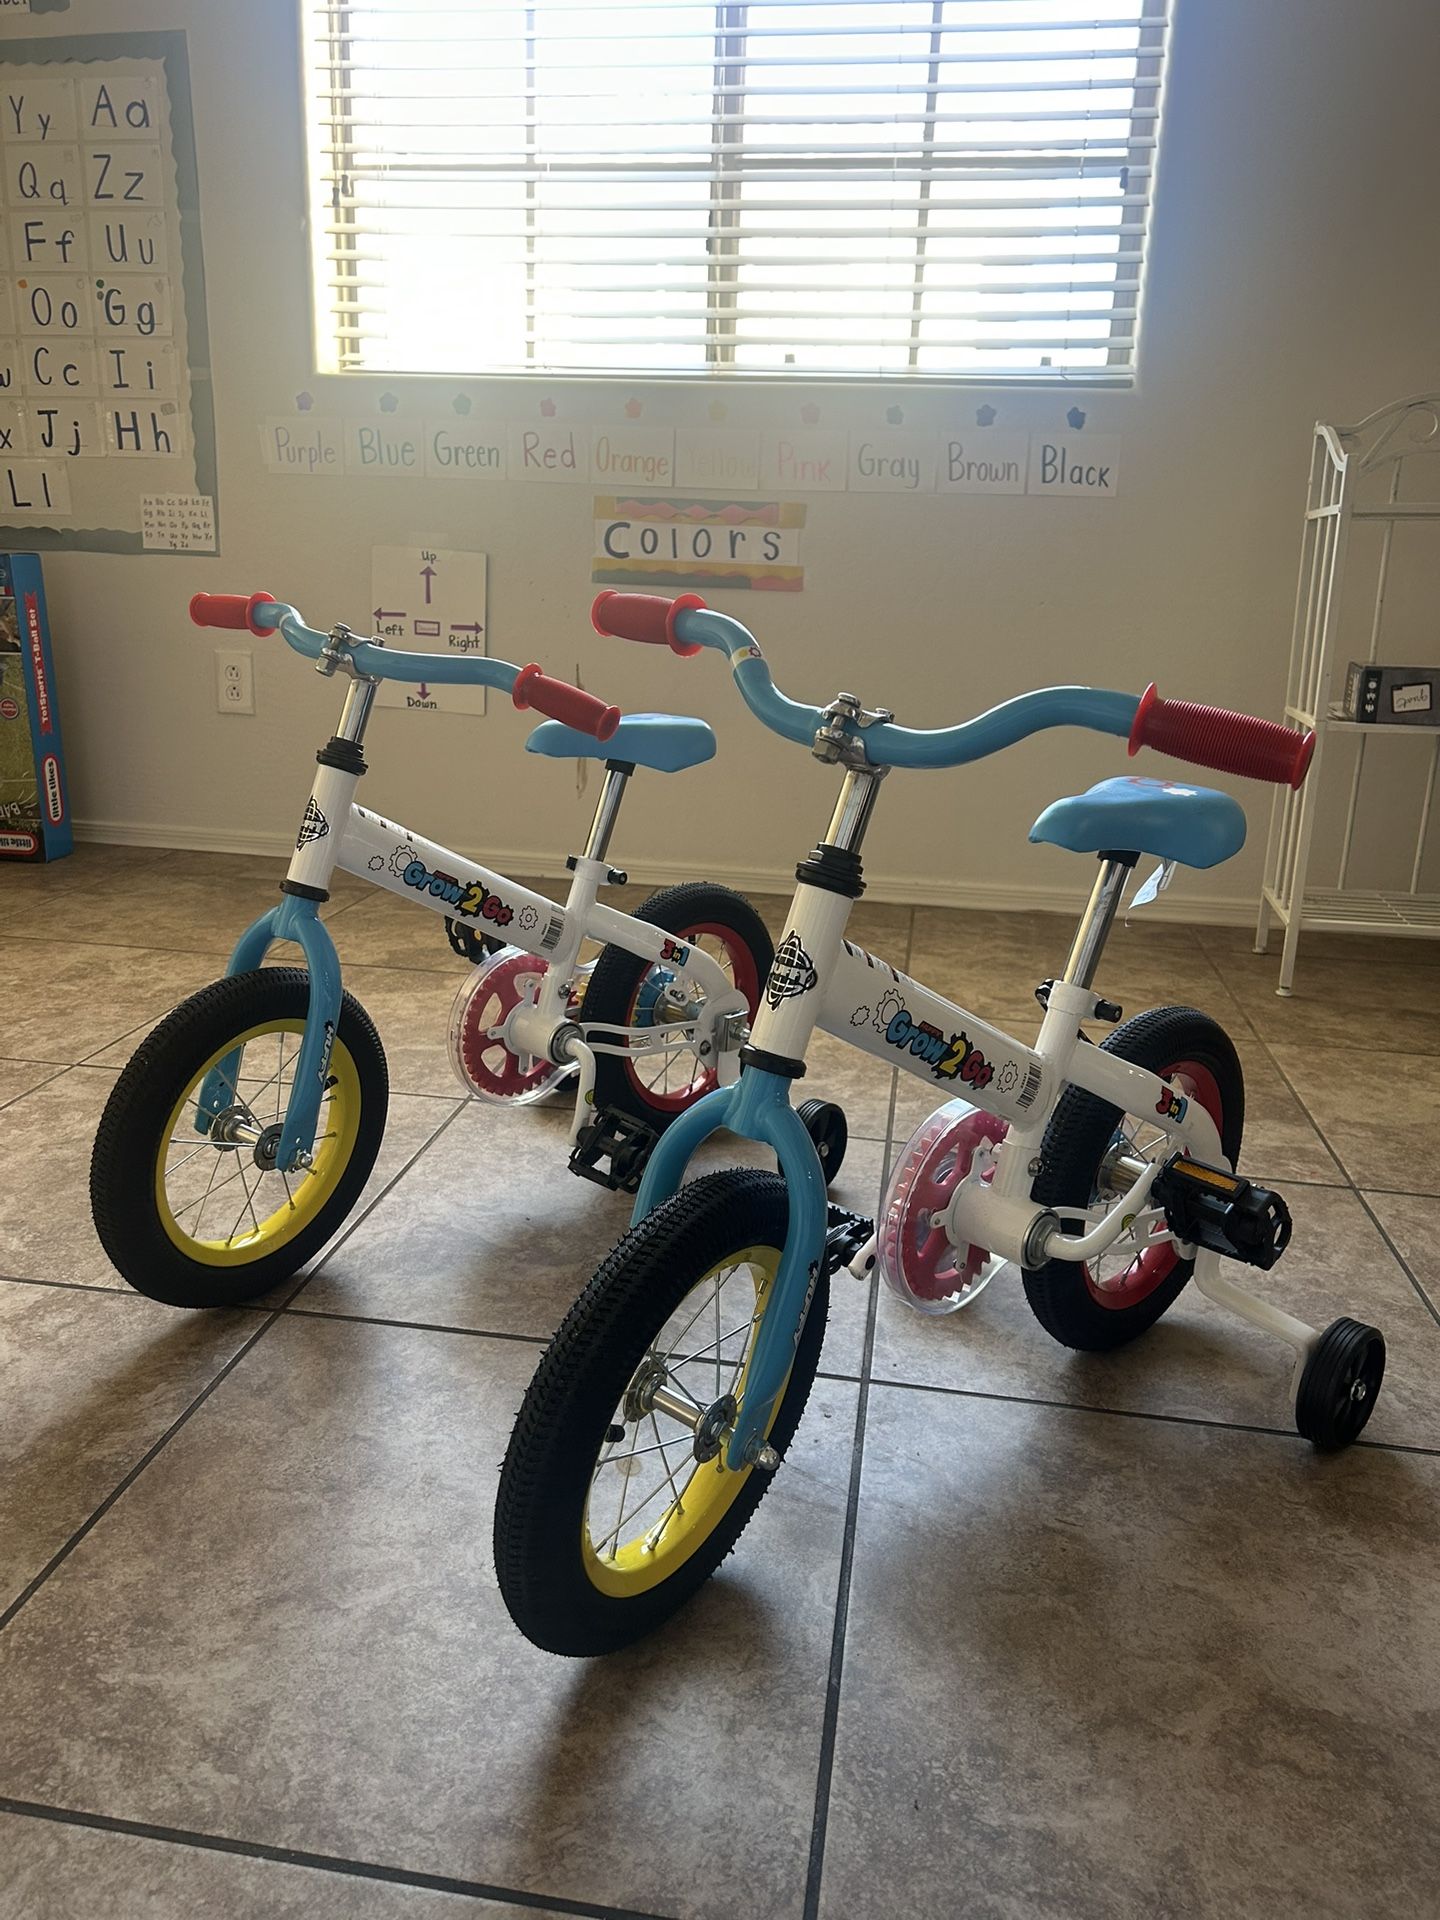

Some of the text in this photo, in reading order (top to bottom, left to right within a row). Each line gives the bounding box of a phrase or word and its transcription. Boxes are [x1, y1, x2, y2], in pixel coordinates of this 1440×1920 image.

[274, 426, 336, 472] Purple
[359, 427, 415, 466] Blue
[433, 430, 500, 469] Green
[523, 431, 577, 469] Red
[596, 436, 669, 482] Orange
[777, 441, 832, 482] Pink
[857, 442, 920, 489] Gray
[948, 441, 1019, 483] Brown
[1041, 444, 1111, 488] Black
[421, 551, 437, 564] Up
[604, 521, 782, 561] Colors
[28, 608, 38, 627] Set
[376, 620, 405, 637] Left
[31, 630, 42, 664] T-Ball
[448, 634, 481, 653] Right
[406, 696, 438, 710] Down
[47, 760, 60, 819] little tikes
[773, 961, 815, 987] UFFY
